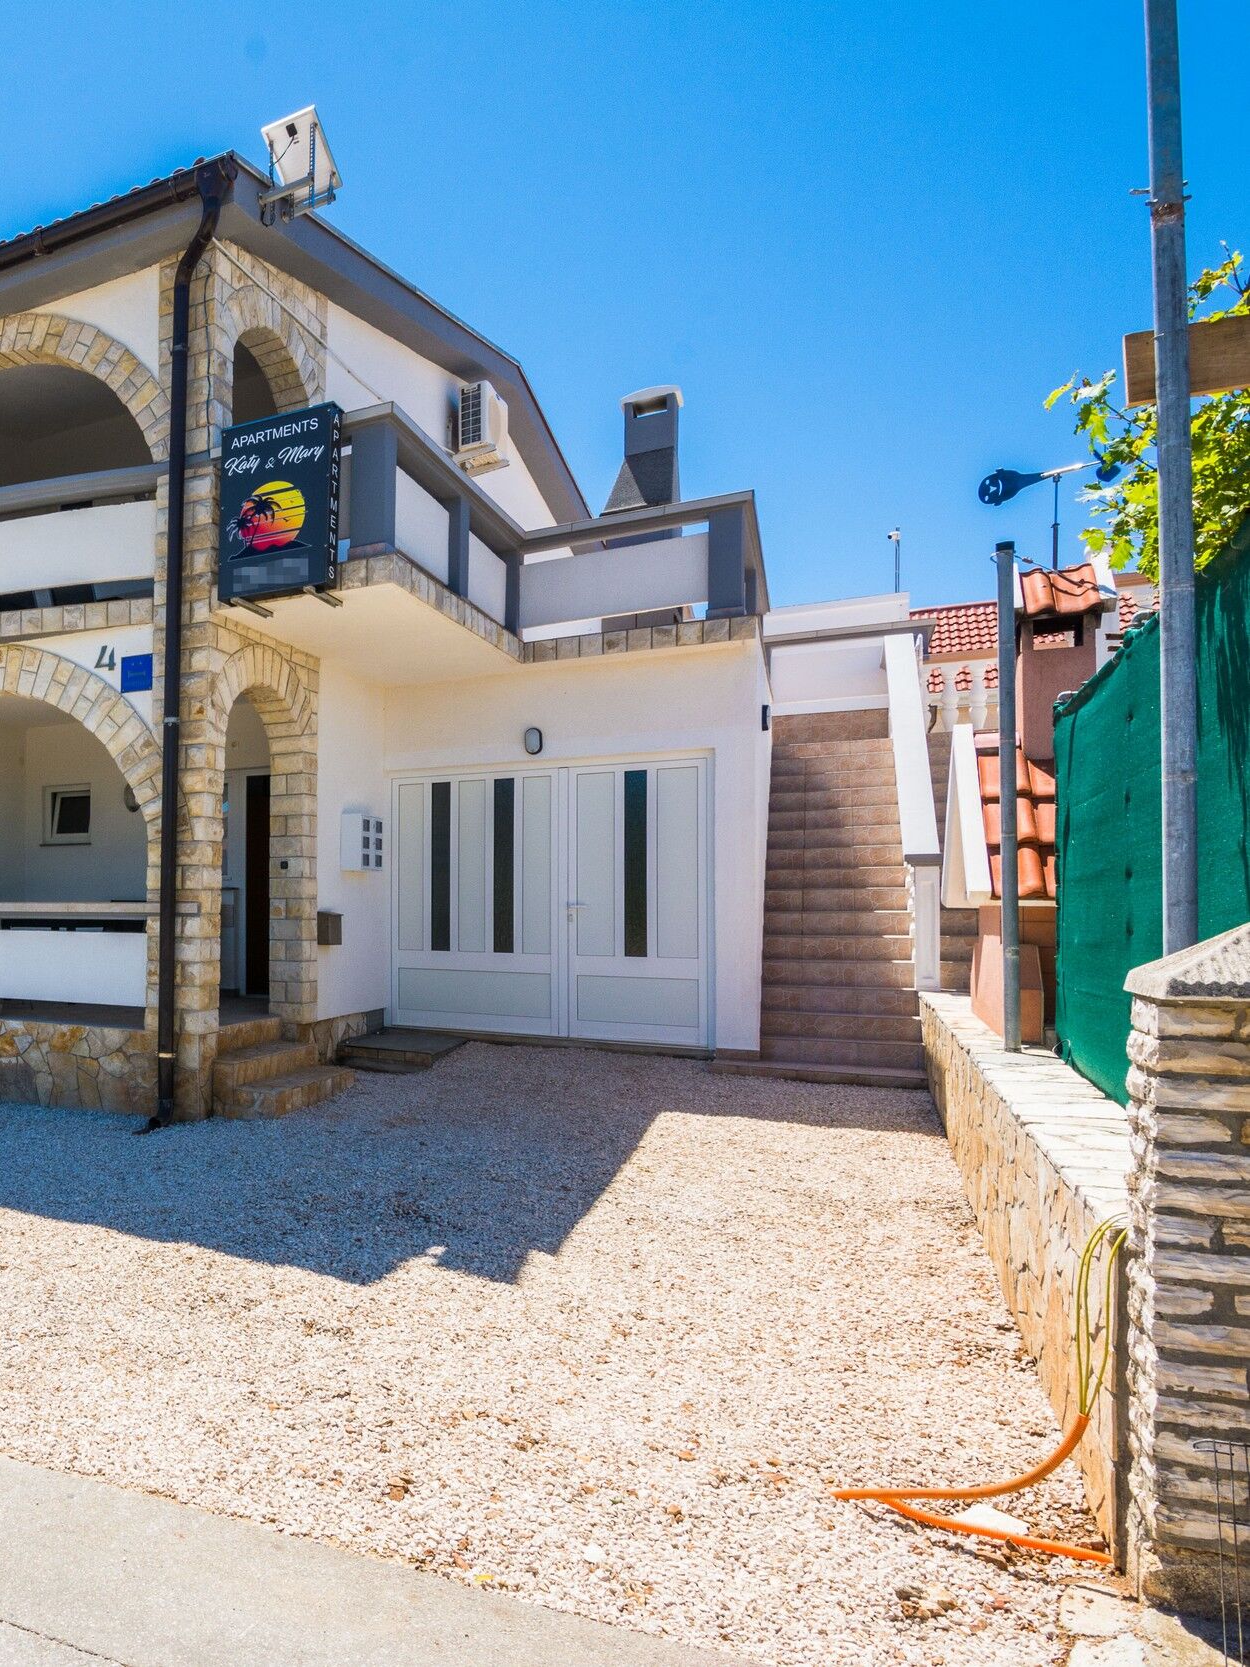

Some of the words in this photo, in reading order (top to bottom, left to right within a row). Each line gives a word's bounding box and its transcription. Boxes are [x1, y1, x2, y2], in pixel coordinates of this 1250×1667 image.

[231, 417, 319, 450] APARTMENTS
[224, 453, 260, 477] Katy
[265, 457, 275, 469] &
[278, 444, 325, 464] Mary
[328, 413, 340, 579] APARTMENTS
[94, 645, 116, 671] 4
